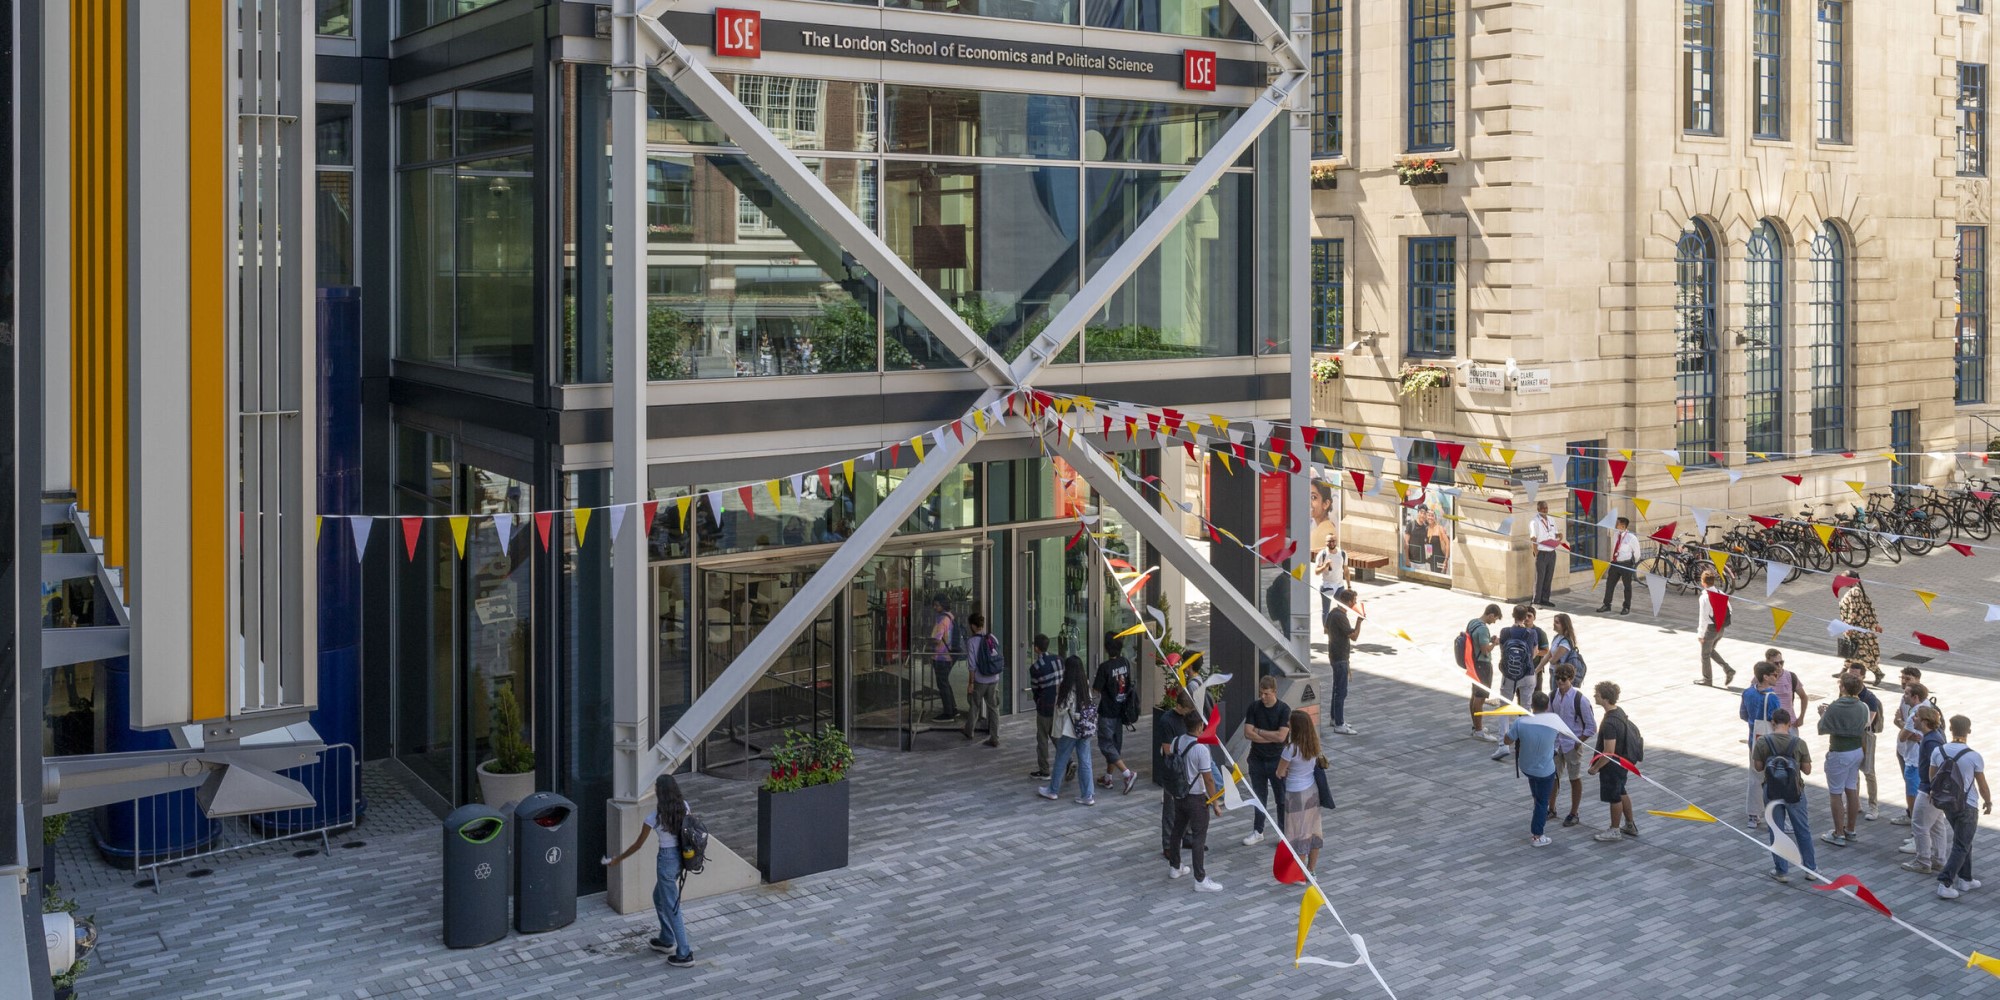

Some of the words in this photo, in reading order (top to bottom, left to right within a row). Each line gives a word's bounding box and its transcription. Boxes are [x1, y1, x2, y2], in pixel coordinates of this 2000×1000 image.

[724, 16, 754, 50] LSE
[802, 31, 831, 48] The
[834, 33, 887, 52] London
[890, 38, 937, 56] School
[940, 43, 955, 57] of
[957, 44, 1028, 63] Economics
[1030, 51, 1054, 65] and
[1056, 52, 1105, 69] Political
[1108, 56, 1154, 73] Science
[1190, 56, 1212, 85] LSE
[1469, 369, 1497, 378] HOUGHTON
[1520, 371, 1534, 379] CLARE
[1469, 377, 1488, 386] STREET
[1489, 379, 1501, 387] WC2
[1520, 378, 1538, 387] MARKET
[1539, 377, 1549, 386] WC2
